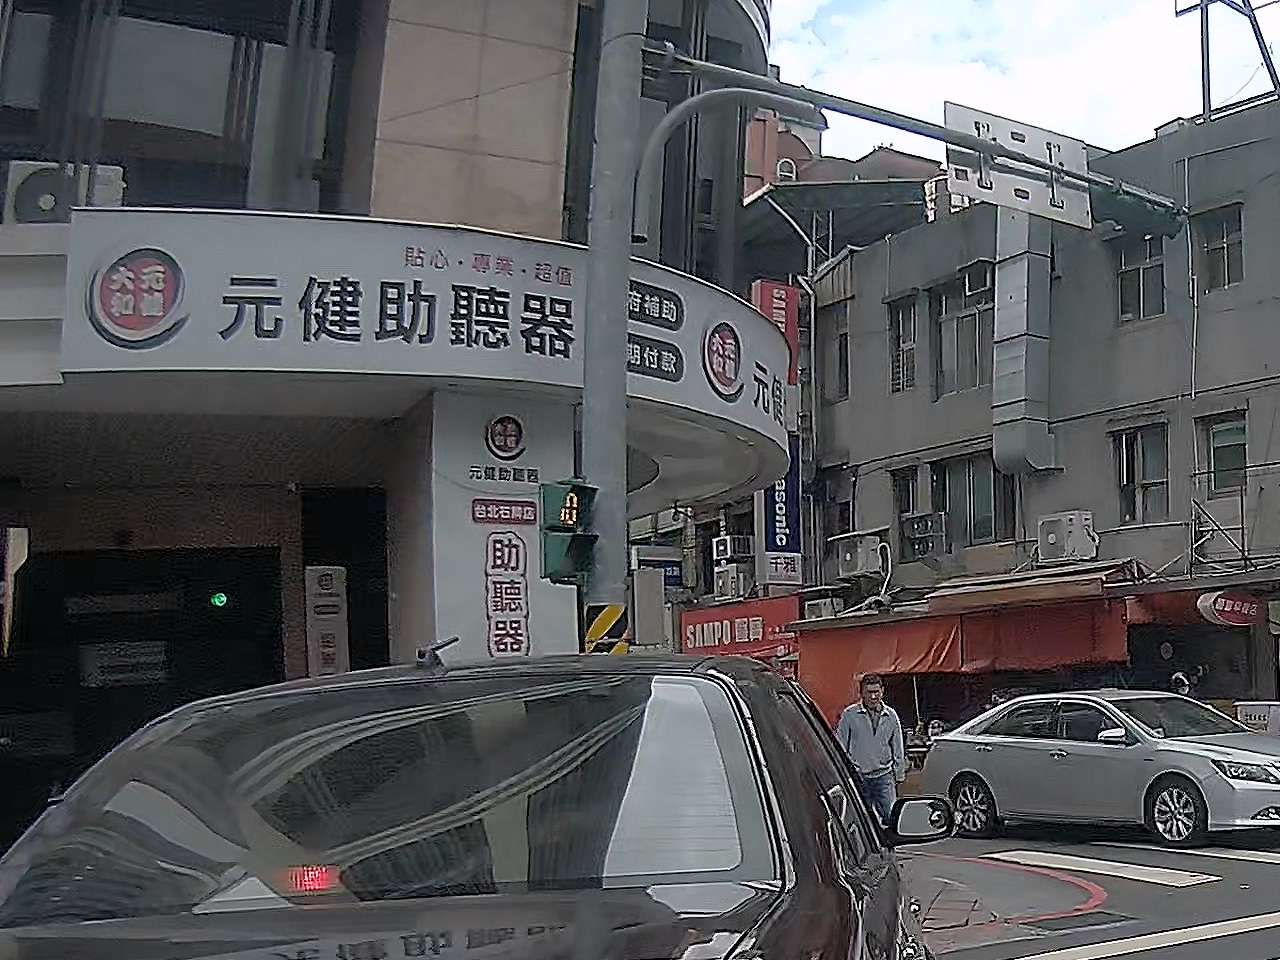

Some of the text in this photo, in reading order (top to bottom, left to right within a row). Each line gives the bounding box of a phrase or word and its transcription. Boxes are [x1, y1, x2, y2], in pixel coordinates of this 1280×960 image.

[216, 274, 577, 360] 元健助聽器
[490, 538, 525, 655] 助聽器
[686, 618, 732, 650] SAMPO
